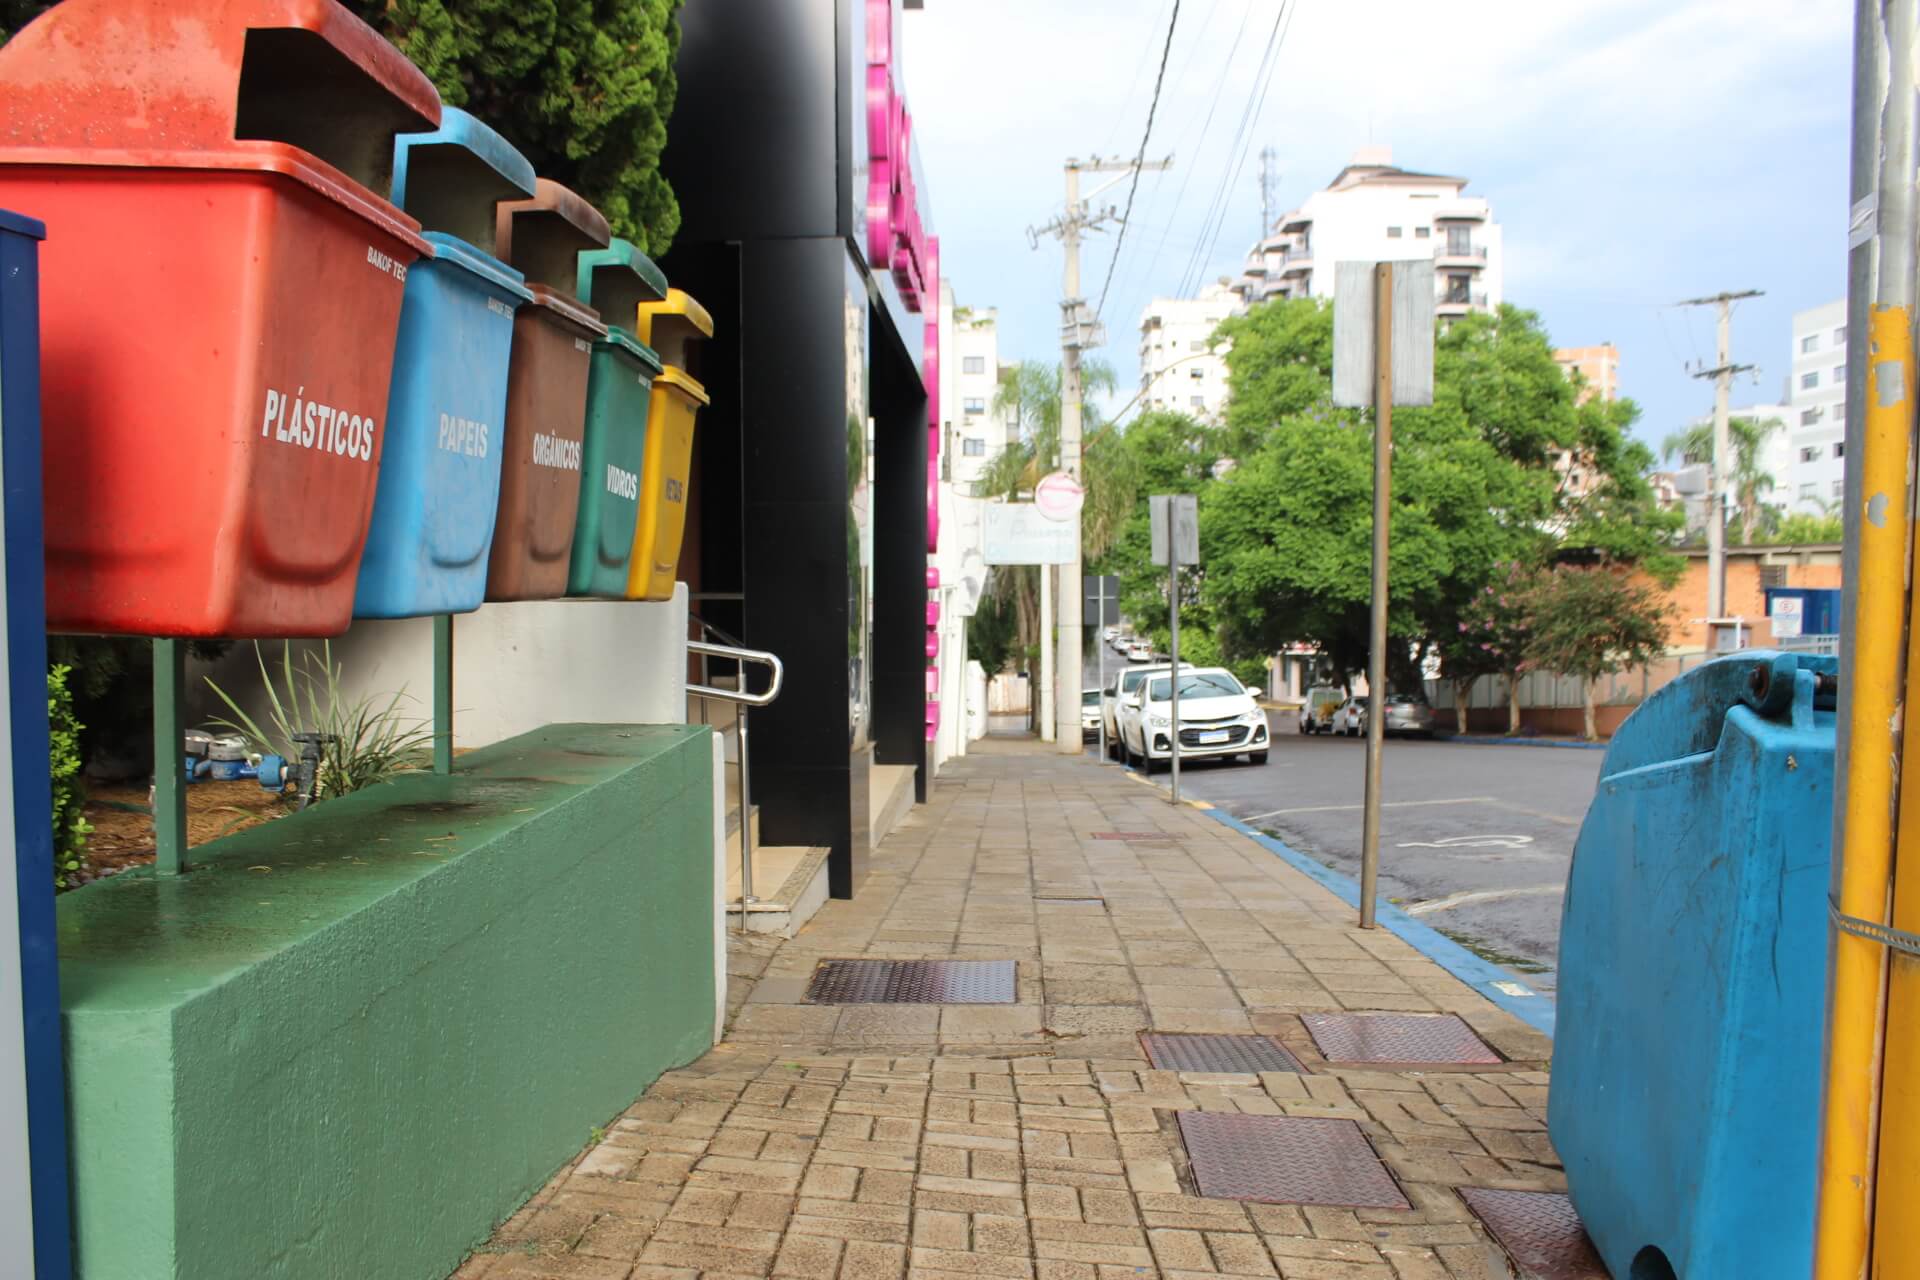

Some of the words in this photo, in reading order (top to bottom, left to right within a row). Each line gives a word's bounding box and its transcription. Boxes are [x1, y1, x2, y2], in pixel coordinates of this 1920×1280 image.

[367, 245, 393, 273] BAKOF
[262, 386, 374, 462] PLÁSTICOS
[438, 413, 489, 459] PAPEIS
[607, 463, 637, 501] VIDROS
